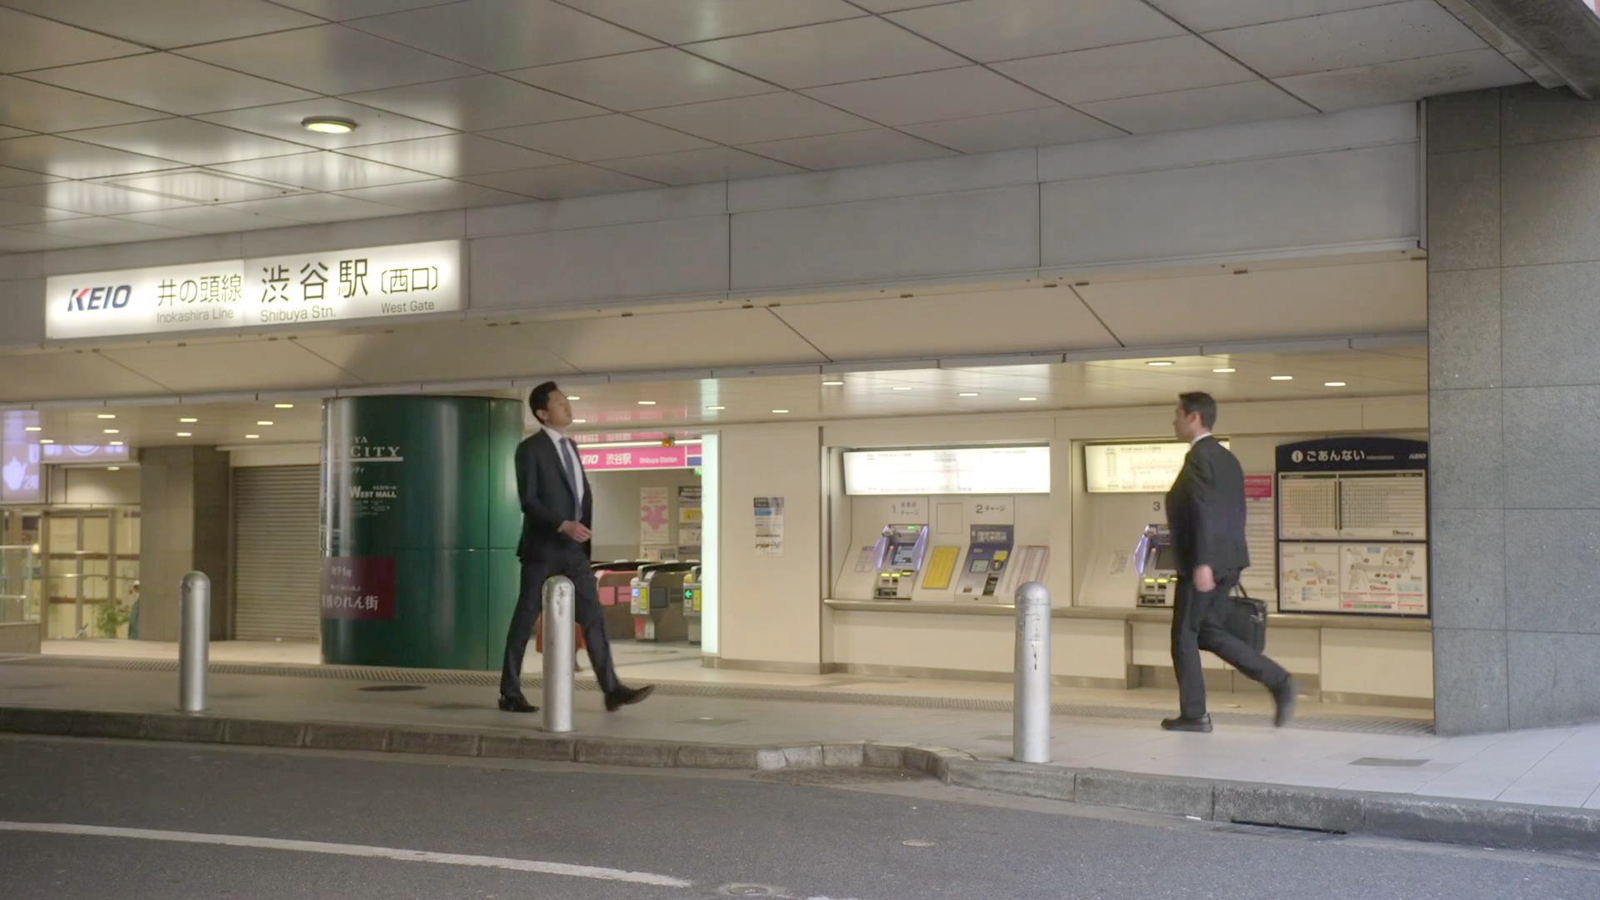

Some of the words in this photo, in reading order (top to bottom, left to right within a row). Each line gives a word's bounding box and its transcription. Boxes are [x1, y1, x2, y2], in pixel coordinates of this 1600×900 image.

[157, 273, 243, 307] 井の頭線
[261, 258, 369, 303] 渋谷駅
[67, 284, 132, 312] KEIO
[260, 306, 308, 323] Shibuya
[311, 305, 337, 319] Stn.
[381, 302, 408, 315] West
[409, 300, 435, 313] Gate
[156, 308, 210, 324] Inokashira
[211, 307, 235, 321] Line
[350, 446, 401, 457] CITY
[1306, 449, 1366, 462] ごあんない
[580, 454, 599, 465] EIO
[605, 453, 633, 466] 渋谷駅
[975, 503, 984, 514] 2
[1153, 501, 1161, 511] 3
